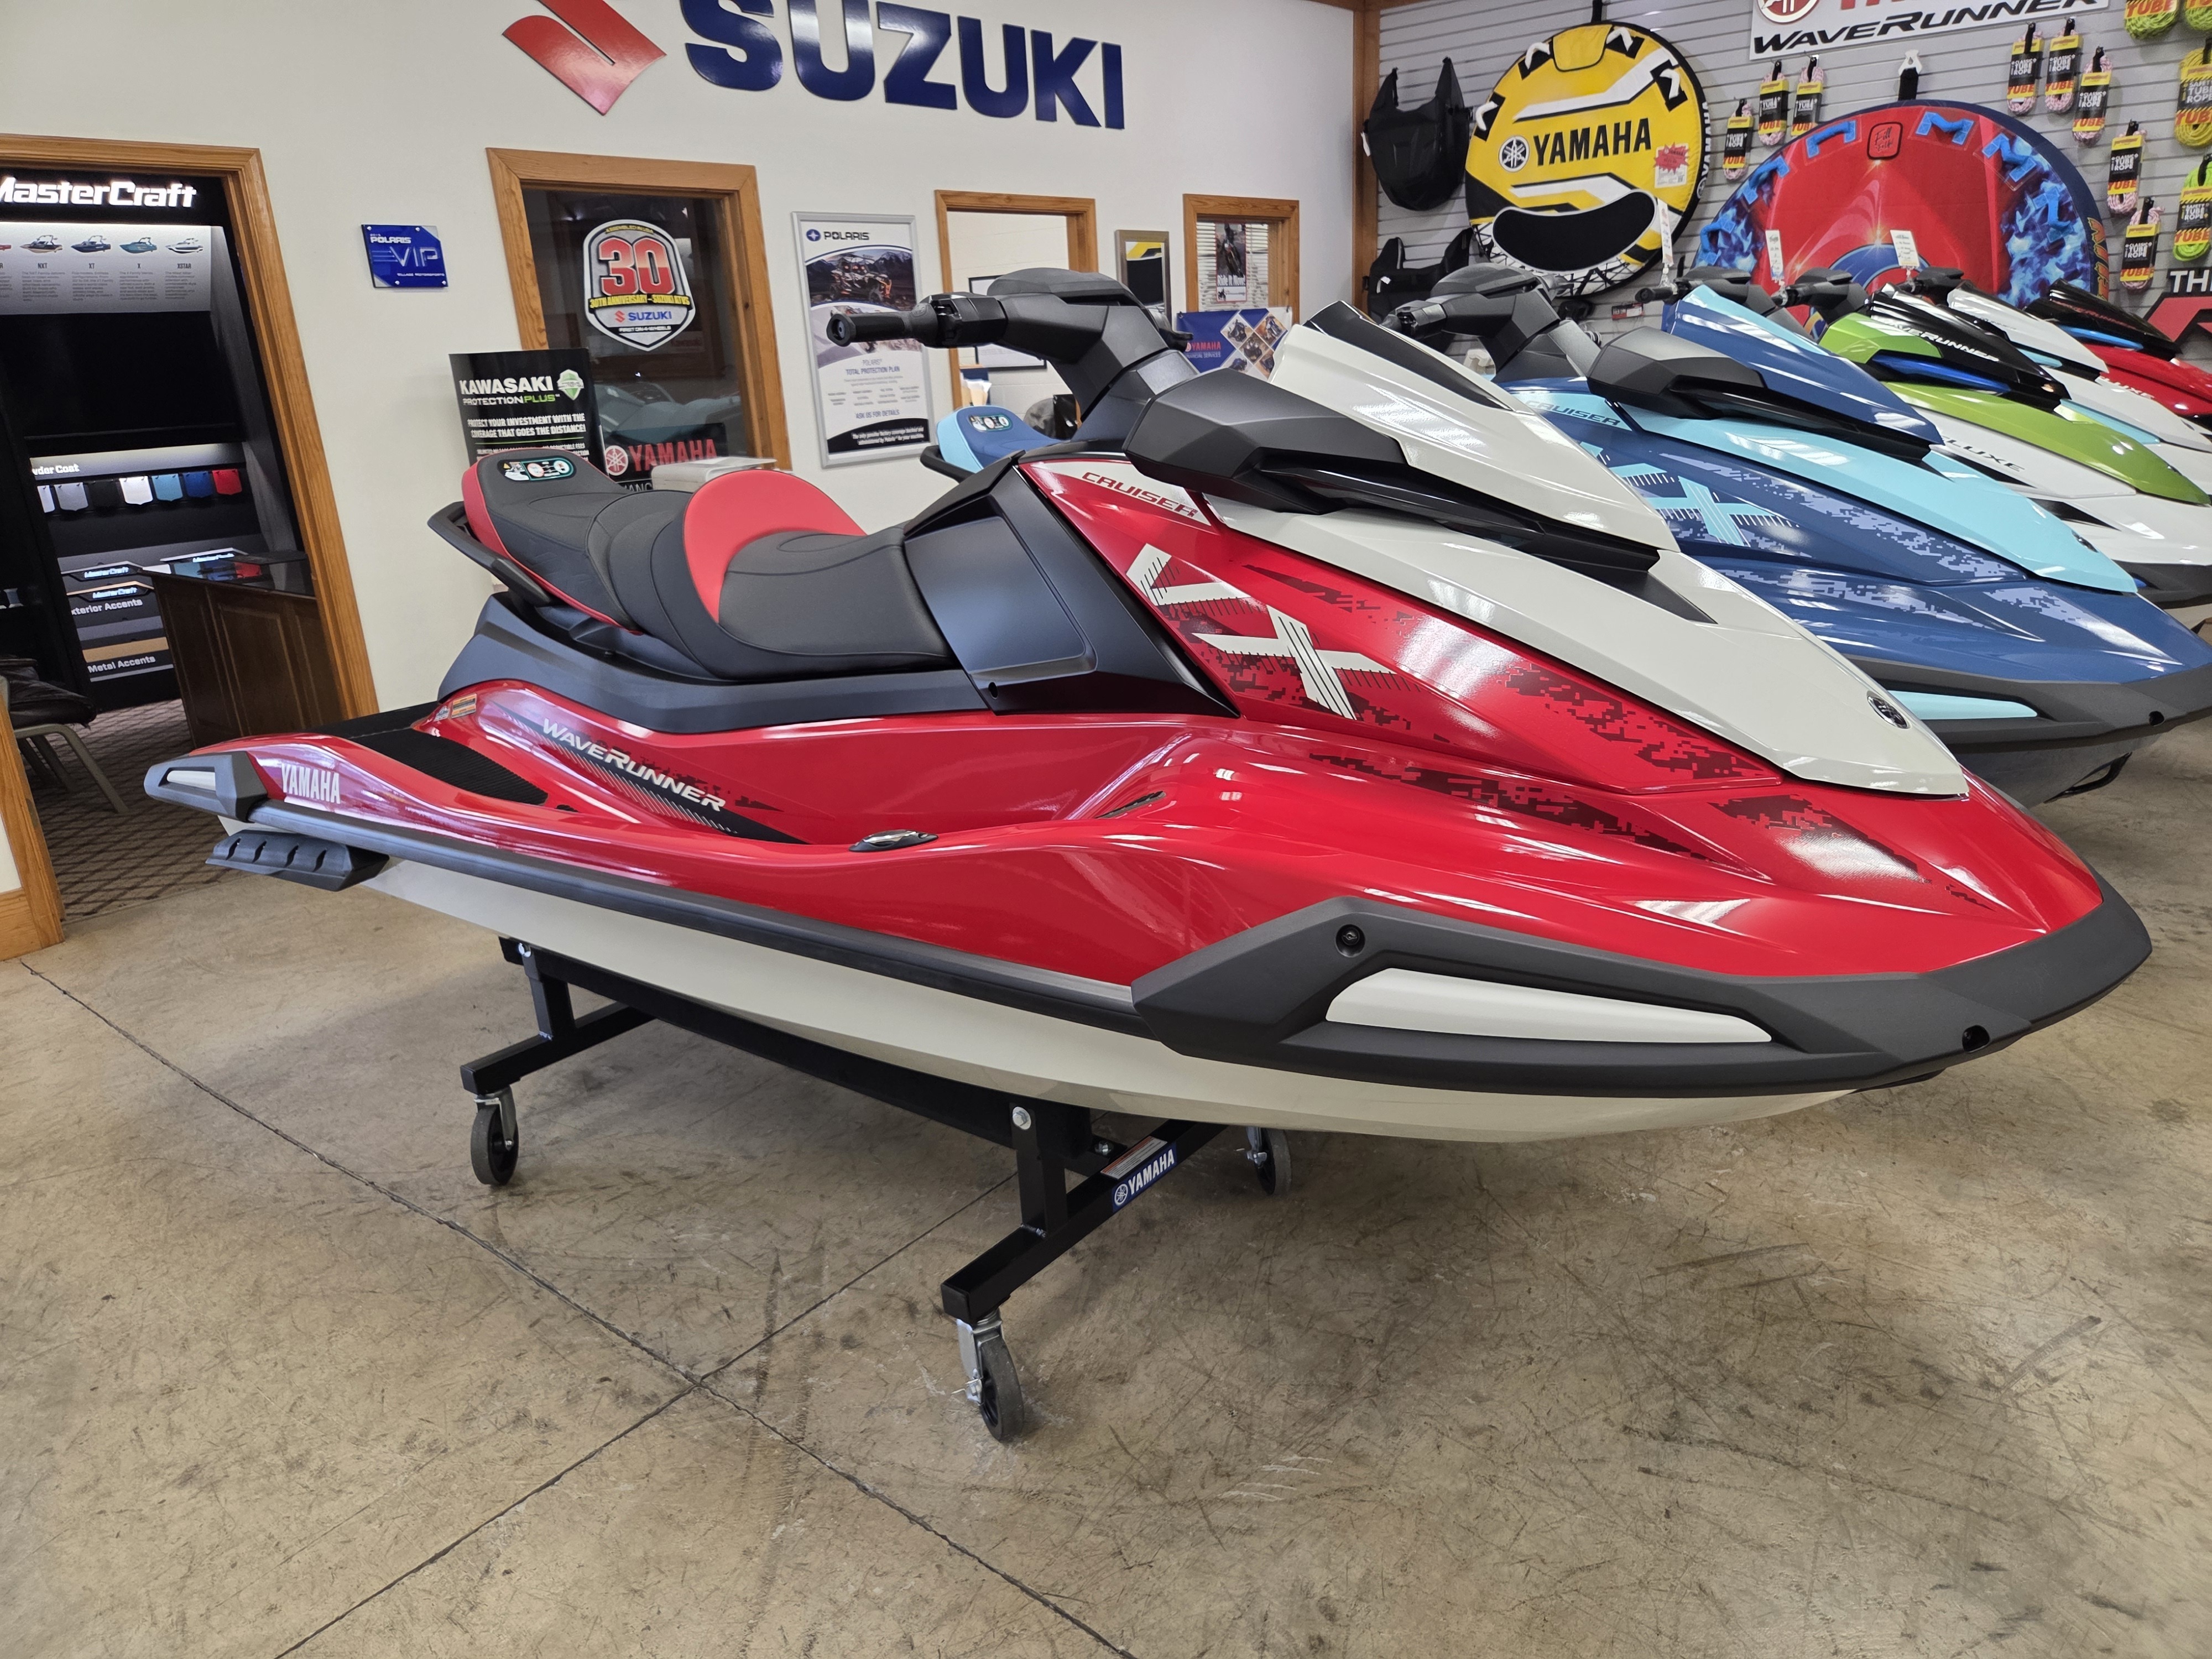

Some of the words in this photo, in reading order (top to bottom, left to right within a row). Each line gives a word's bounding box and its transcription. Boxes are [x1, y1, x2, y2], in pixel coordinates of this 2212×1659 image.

[1754, 0, 2099, 54] WAVERUNNER
[682, 0, 1125, 129] SUZUKI
[2007, 85, 2034, 94] TUBE
[2046, 82, 2074, 92] TUBE
[2073, 117, 2105, 127] TUBE
[2176, 110, 2212, 125] TUB
[1533, 118, 1651, 166] YAMAHA
[2108, 180, 2137, 190] TUBE
[823, 231, 870, 240] POLARIS
[2175, 231, 2210, 243] TUBE
[389, 246, 438, 267] VIP
[599, 237, 675, 296] 30
[2121, 268, 2150, 276] TUBE
[1218, 274, 1228, 286] Ride
[2170, 269, 2212, 293] TH
[628, 311, 672, 321] SUZUKI
[1192, 342, 1220, 351] YAMAHA
[459, 376, 553, 394] KAWASAKI
[488, 418, 505, 426] YOUR
[506, 415, 552, 426] INVESTMENT
[552, 414, 571, 423] WITH
[572, 413, 585, 421] THE
[1526, 400, 1621, 426] CRUISER
[498, 427, 515, 437] THAT
[515, 426, 535, 437] GOES
[535, 426, 550, 435] THE
[628, 439, 717, 471] YAMAHA
[1942, 436, 2025, 472] LUXE
[56, 463, 79, 473] Coat
[1082, 472, 1198, 517] CRUISER
[105, 599, 143, 611] Accents
[88, 662, 116, 673] Metal
[118, 655, 156, 668] Accents
[543, 718, 726, 812] WAVERUNNER
[281, 763, 340, 804] YAMAHA
[1128, 1149, 1175, 1195] YAMAHA
